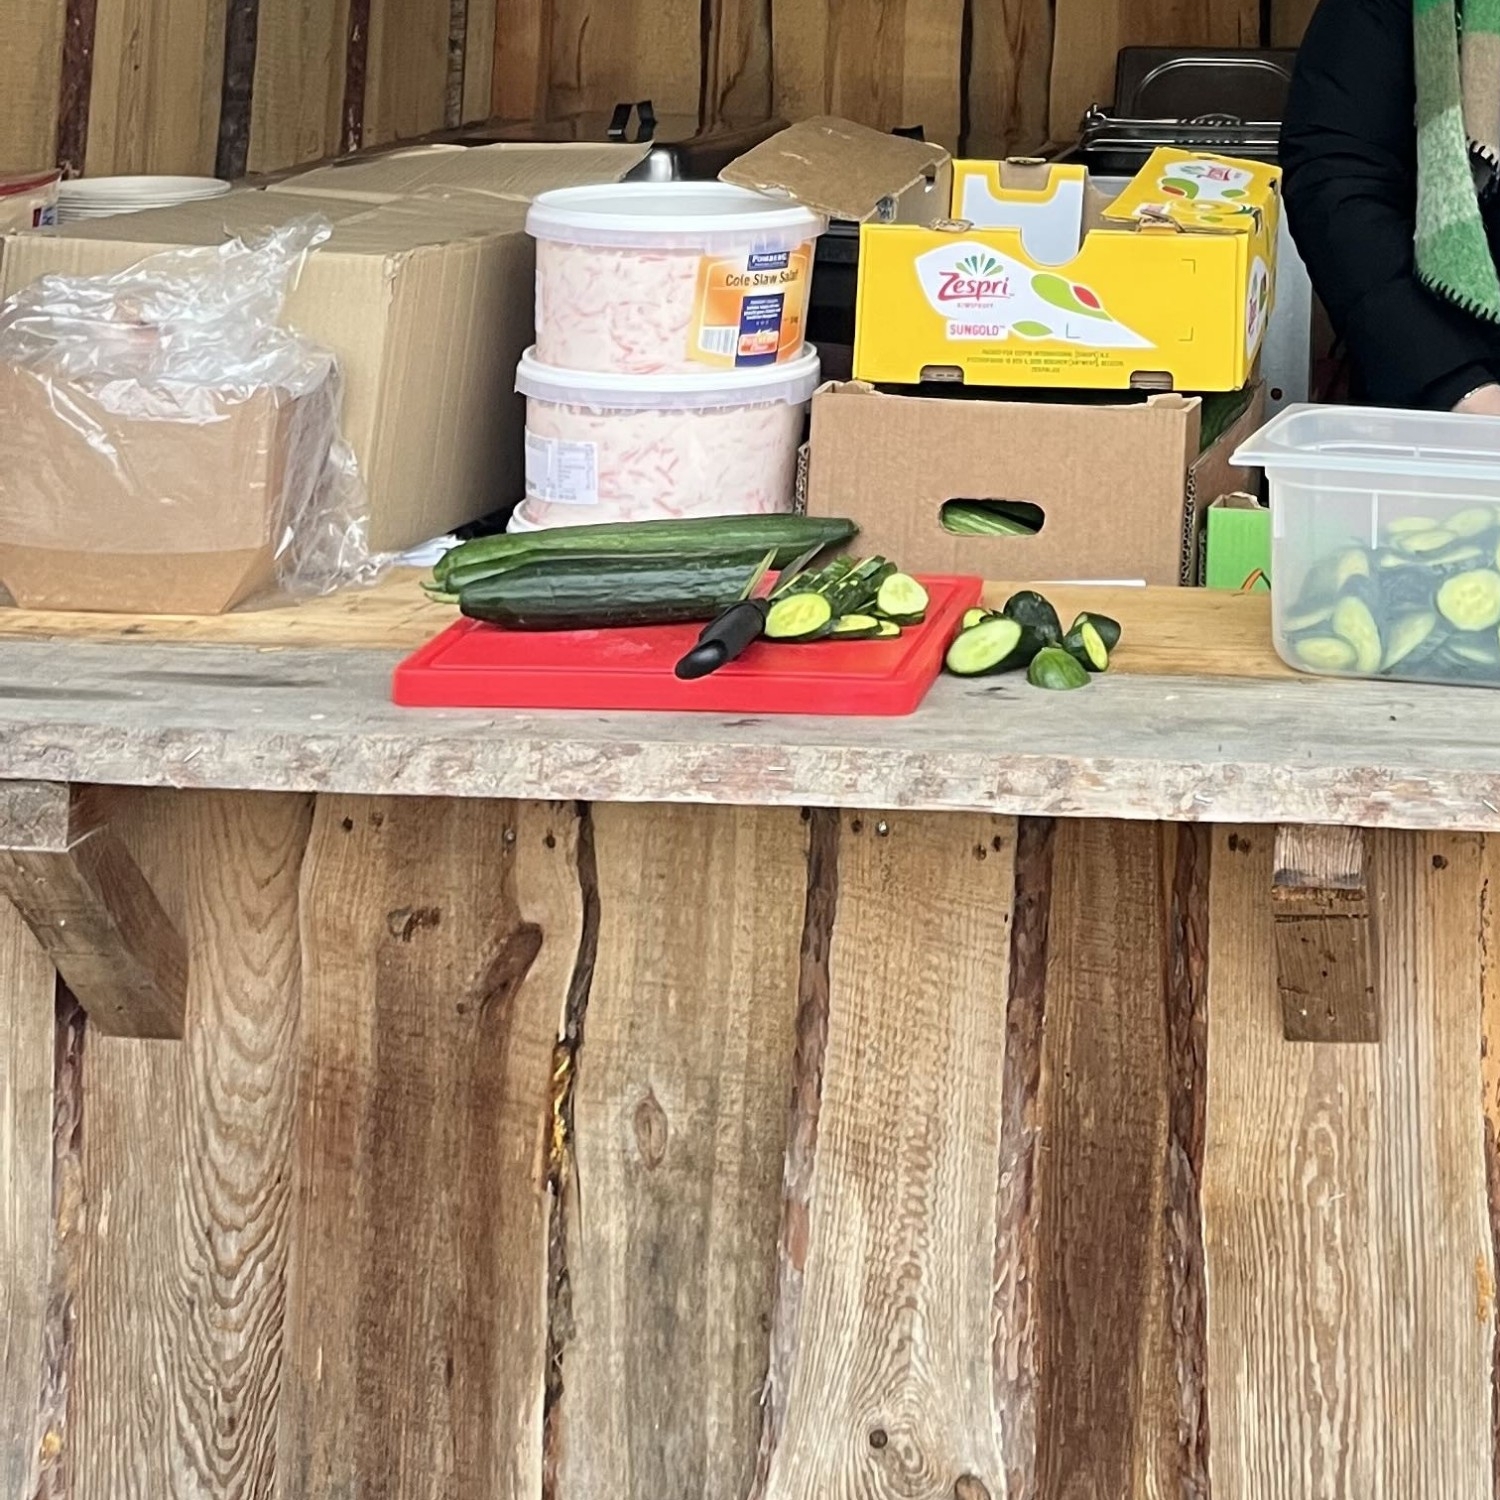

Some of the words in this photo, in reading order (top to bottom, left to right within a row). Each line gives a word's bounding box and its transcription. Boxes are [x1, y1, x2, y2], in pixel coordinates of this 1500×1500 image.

[725, 273, 750, 287] Cole
[752, 273, 777, 286] Slaw
[938, 271, 1010, 301] Zespri
[949, 324, 1000, 336] SUNGOLD
